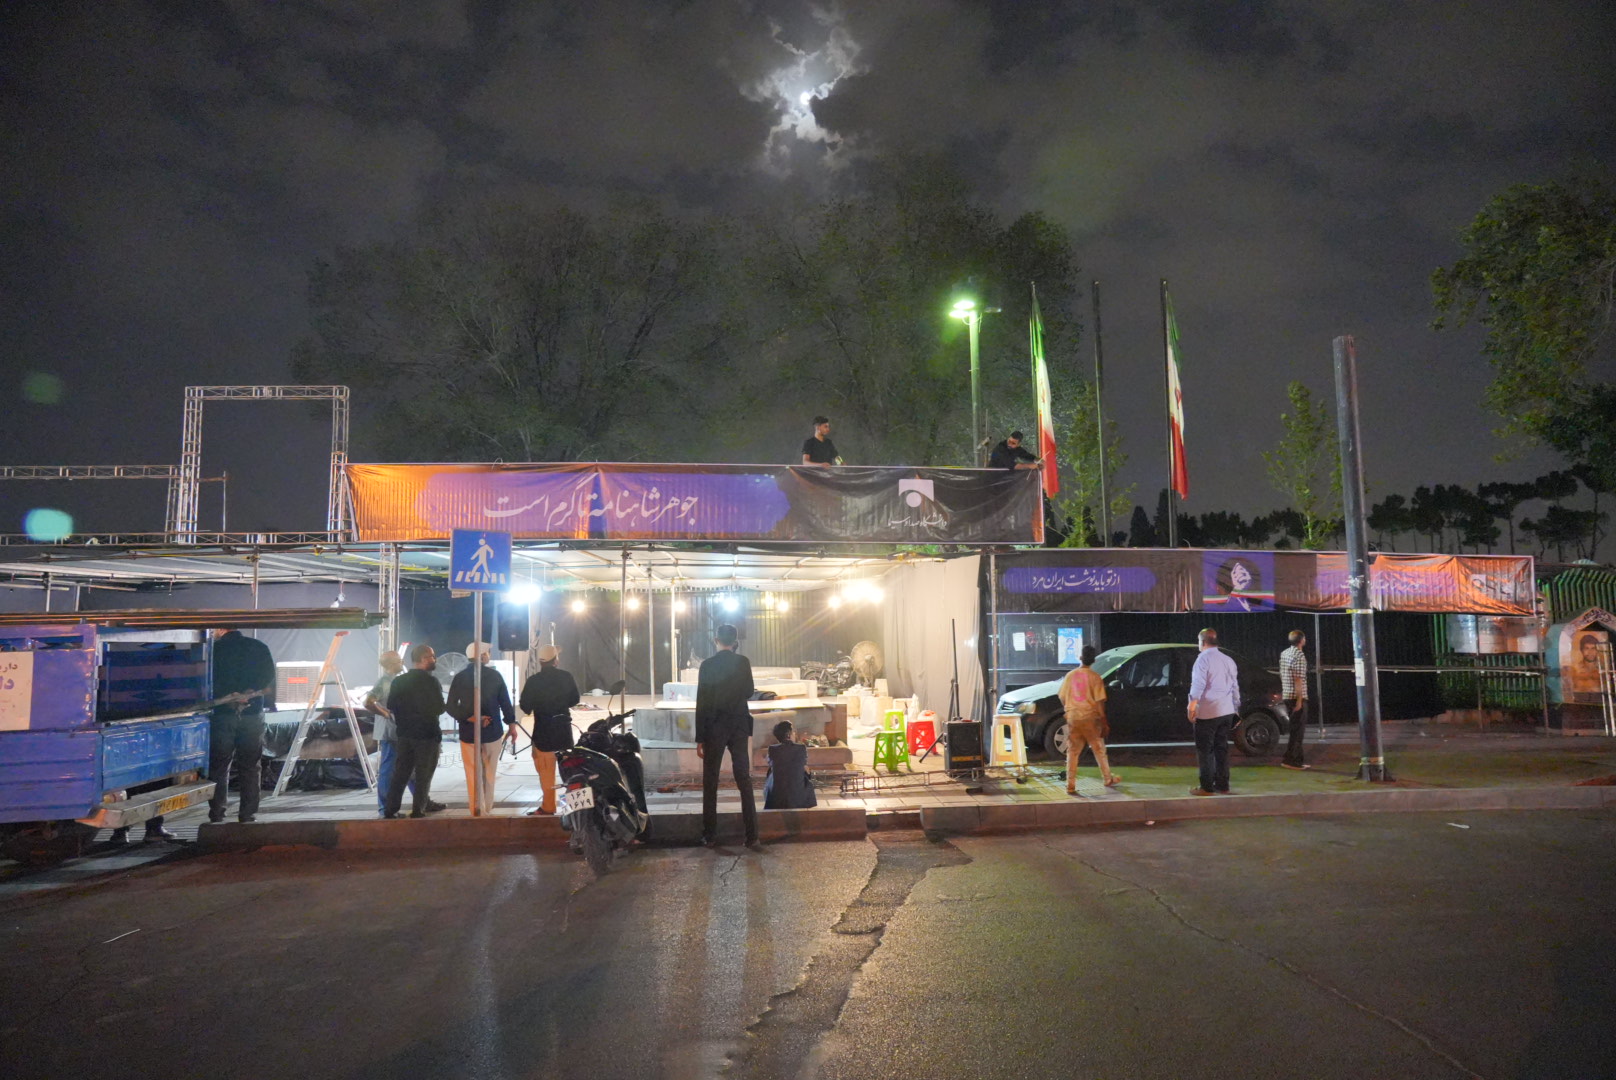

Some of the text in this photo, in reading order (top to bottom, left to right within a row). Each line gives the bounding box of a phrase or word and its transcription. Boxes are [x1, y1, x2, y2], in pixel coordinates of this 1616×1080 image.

[483, 488, 550, 518] است
[545, 472, 599, 532] گرم
[588, 486, 661, 527] شاهنامه
[650, 496, 699, 526] جوهر
[919, 512, 948, 527] دانشگاه
[1064, 569, 1096, 586] نوشت
[1092, 573, 1105, 591] باید
[1104, 569, 1113, 587] تو
[1111, 573, 1120, 586] از
